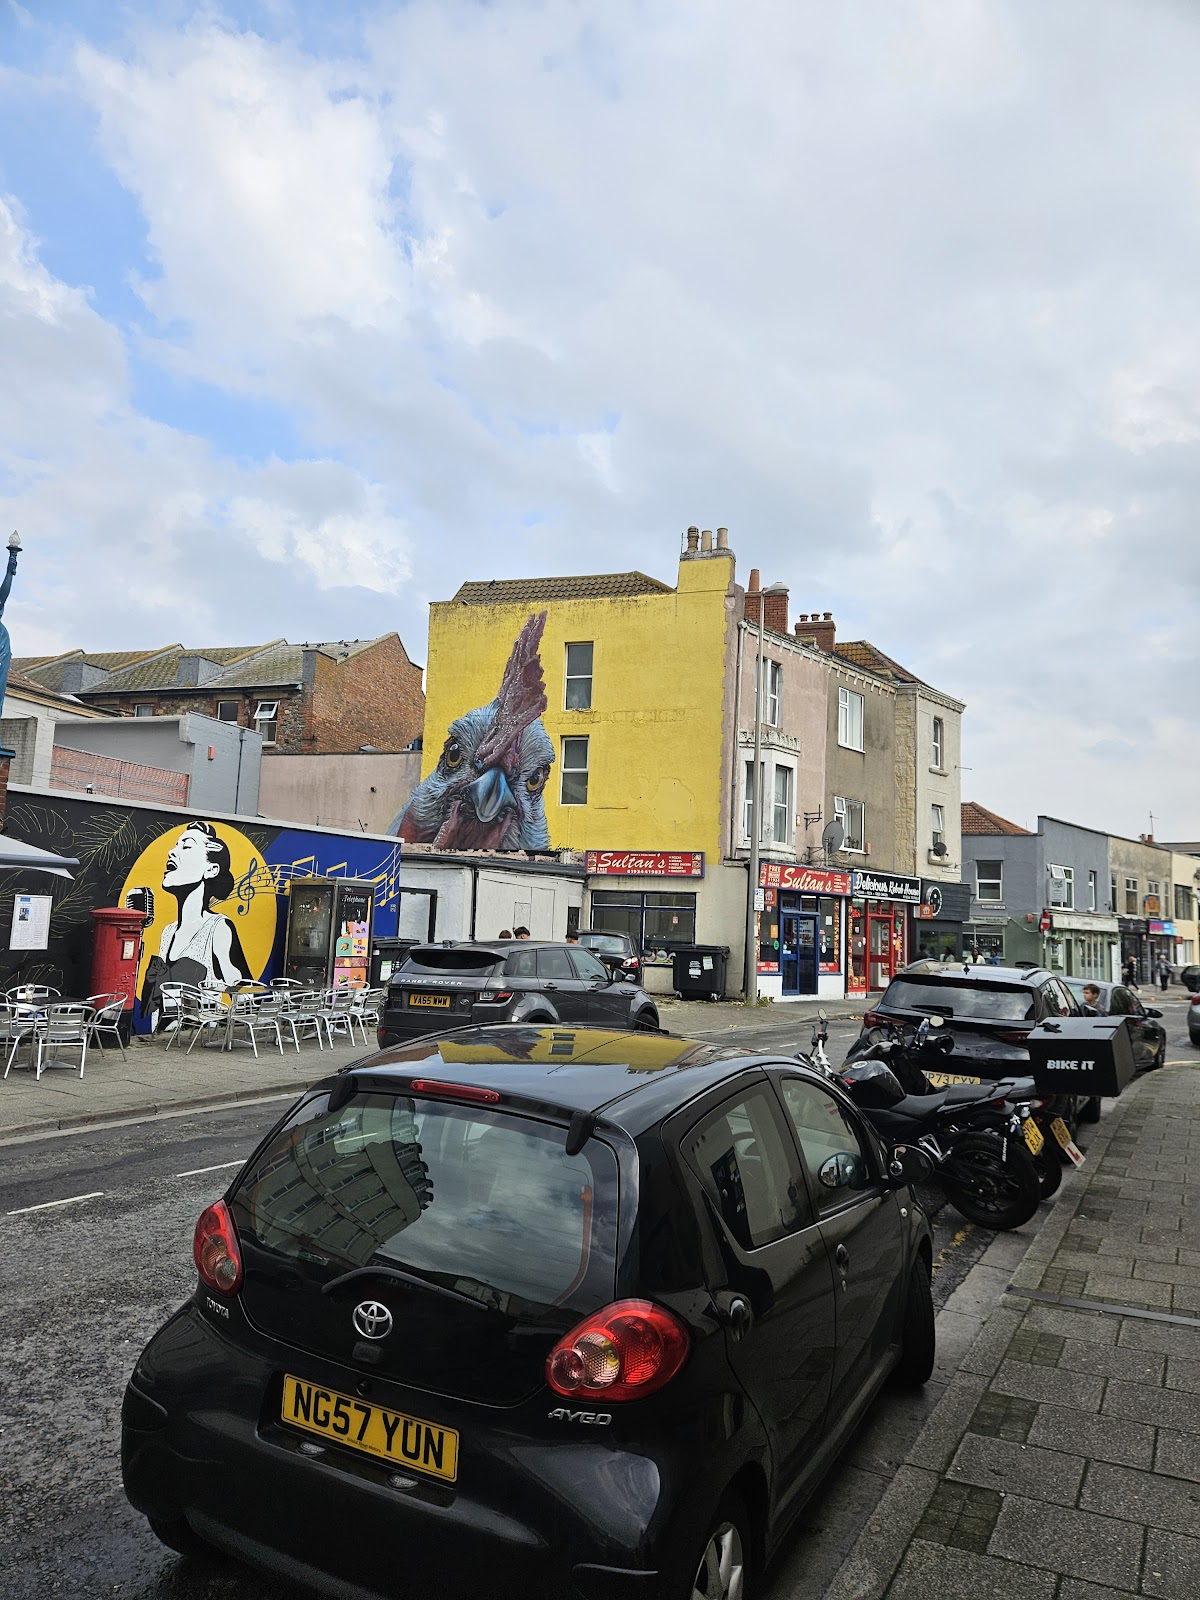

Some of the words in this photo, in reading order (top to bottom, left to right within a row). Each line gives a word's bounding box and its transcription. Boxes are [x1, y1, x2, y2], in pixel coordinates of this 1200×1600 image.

[855, 872, 888, 893] Delicious
[889, 880, 904, 895] Kebab
[904, 883, 920, 897] House
[1047, 1059, 1079, 1070] BIKE
[1081, 1060, 1095, 1071] IT
[207, 1296, 230, 1319] TOYOTA
[294, 1381, 372, 1442] NG57
[382, 1412, 444, 1469] YUN
[548, 1408, 612, 1426] AYGO
